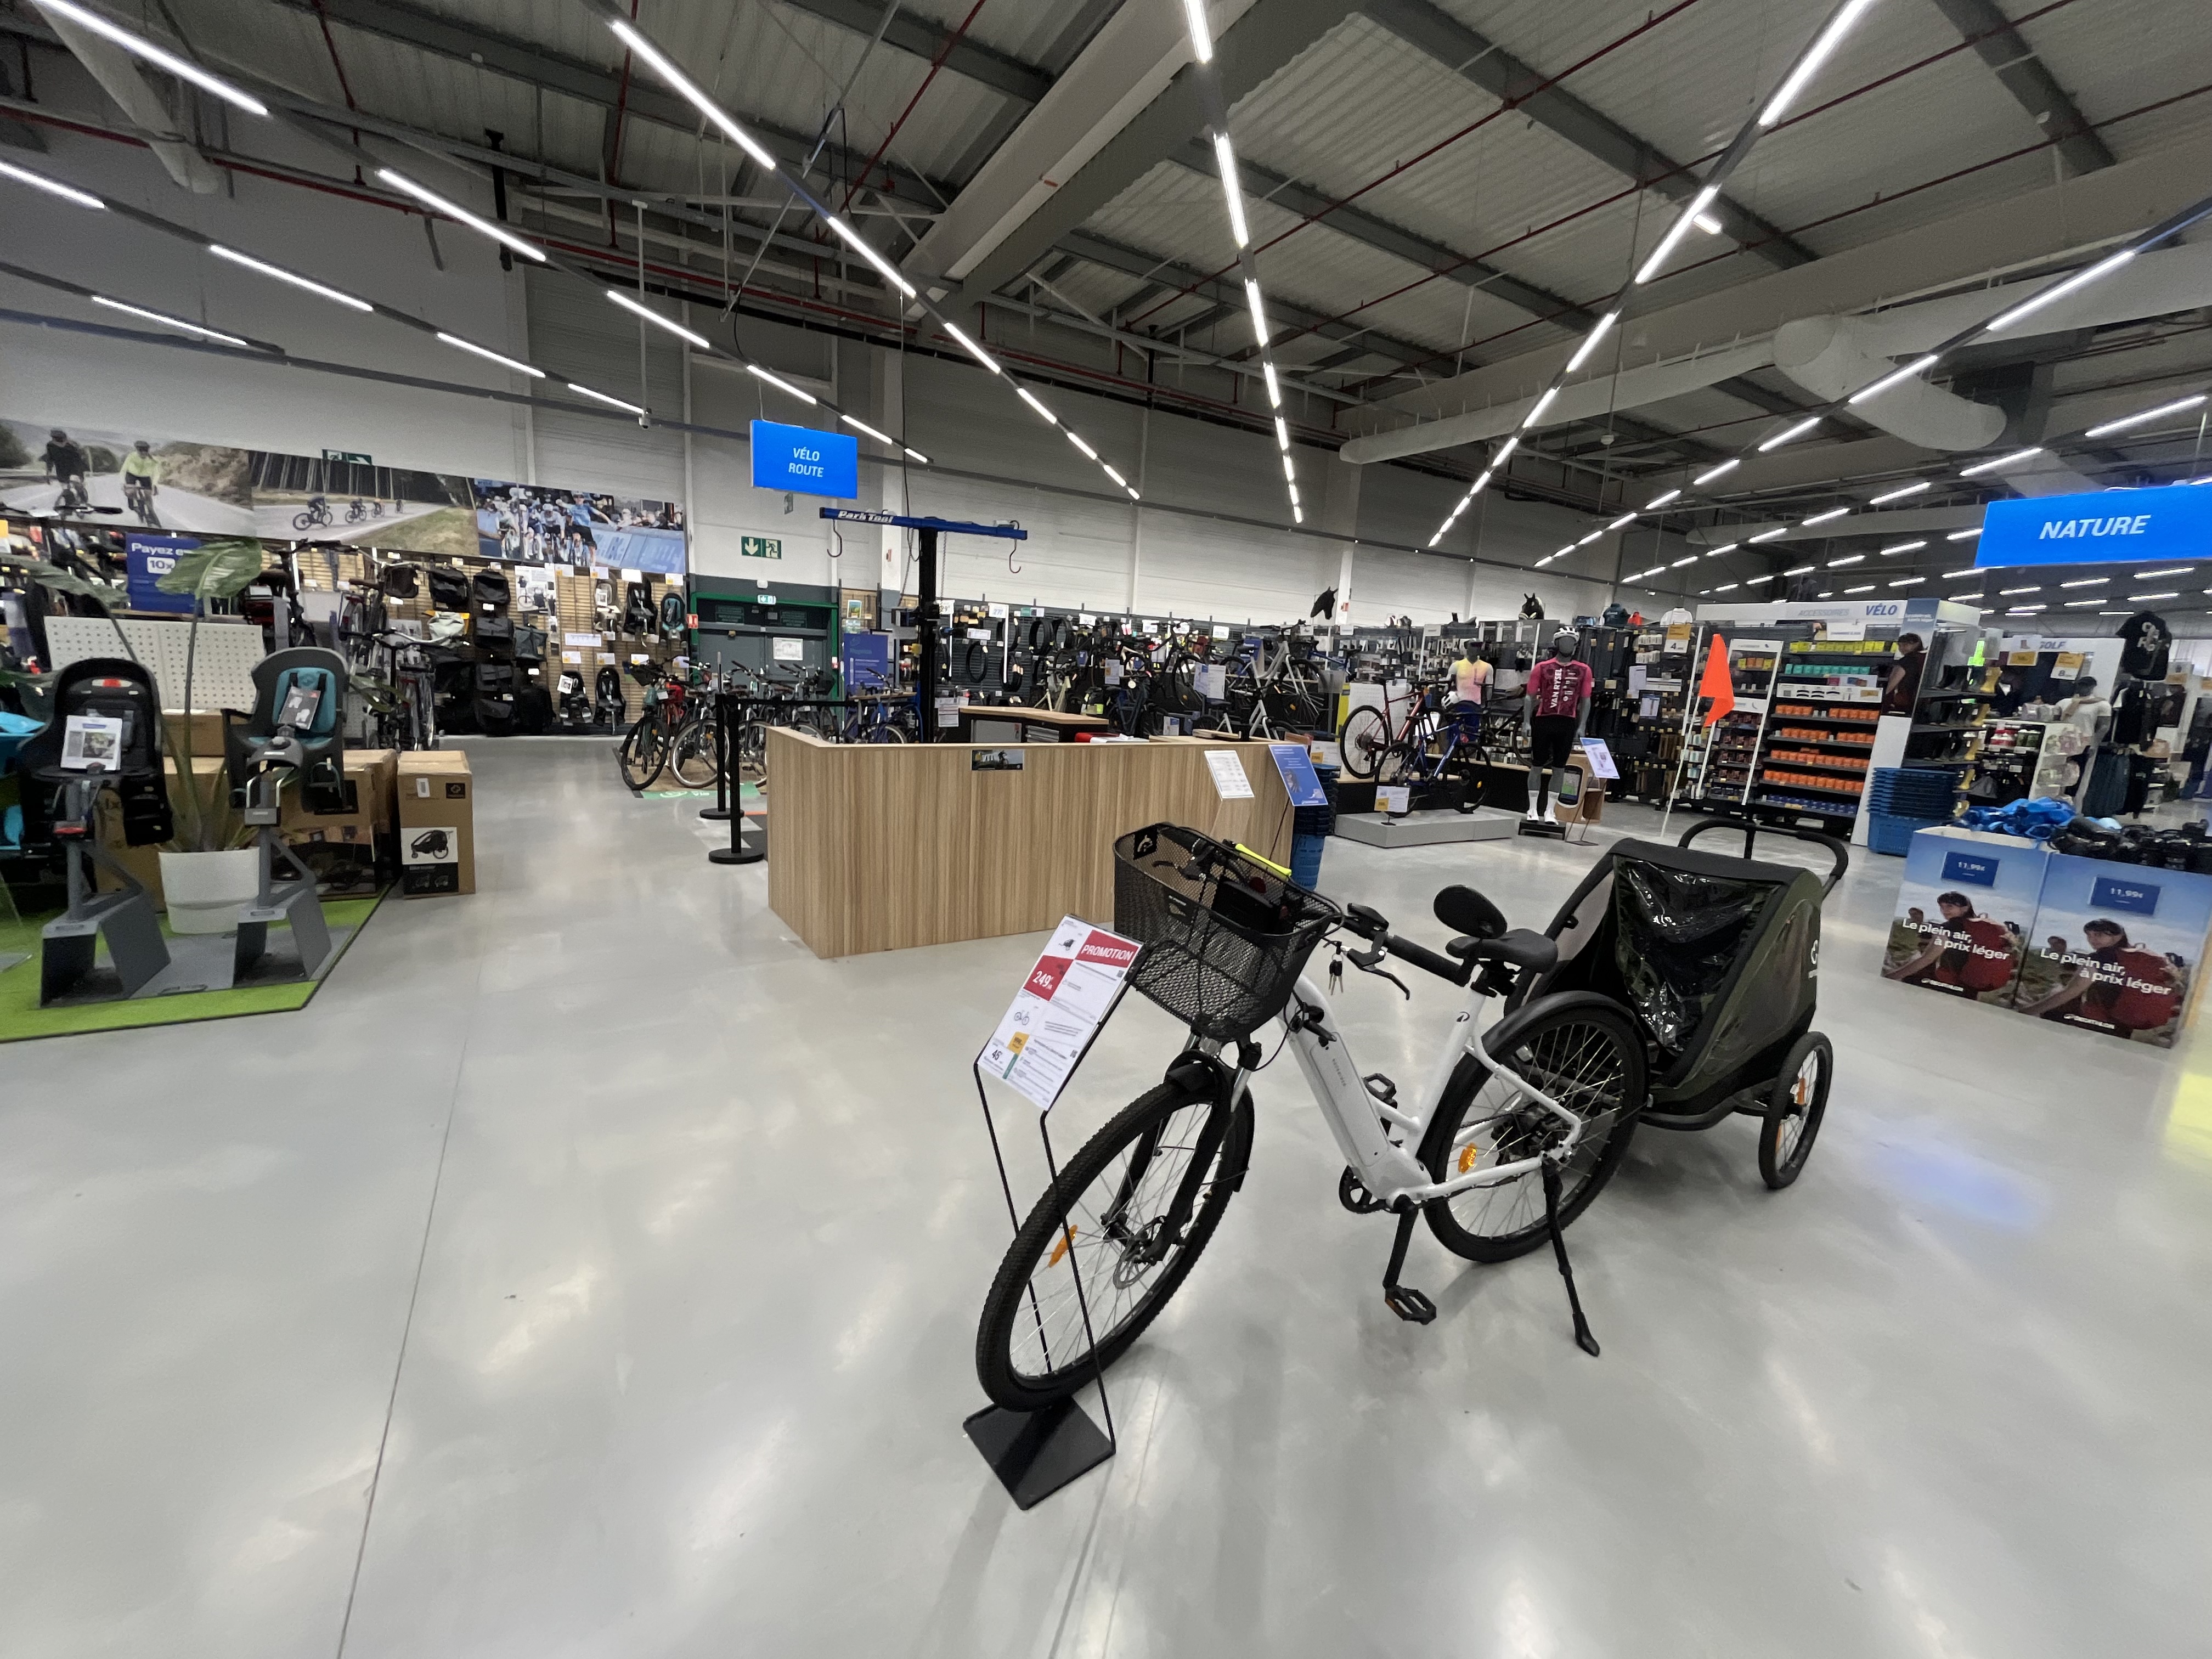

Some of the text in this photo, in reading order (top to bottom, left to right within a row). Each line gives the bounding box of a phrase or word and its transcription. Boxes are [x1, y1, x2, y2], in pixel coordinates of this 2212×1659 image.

[793, 447, 820, 462] VÉLO
[788, 463, 824, 477] ROUTE
[838, 510, 867, 521] Park
[2038, 515, 2151, 540] NATURE
[131, 542, 173, 555] Payez
[1866, 603, 1898, 616] VÉLO
[1550, 668, 1562, 708] VAN RYSEL
[1903, 918, 1973, 944] Le plein air,
[1081, 944, 1134, 961] PROMOTION
[1934, 936, 2011, 960] à prix léger
[2040, 947, 2125, 976] Le plein air,
[2080, 967, 2172, 995] à prix léger
